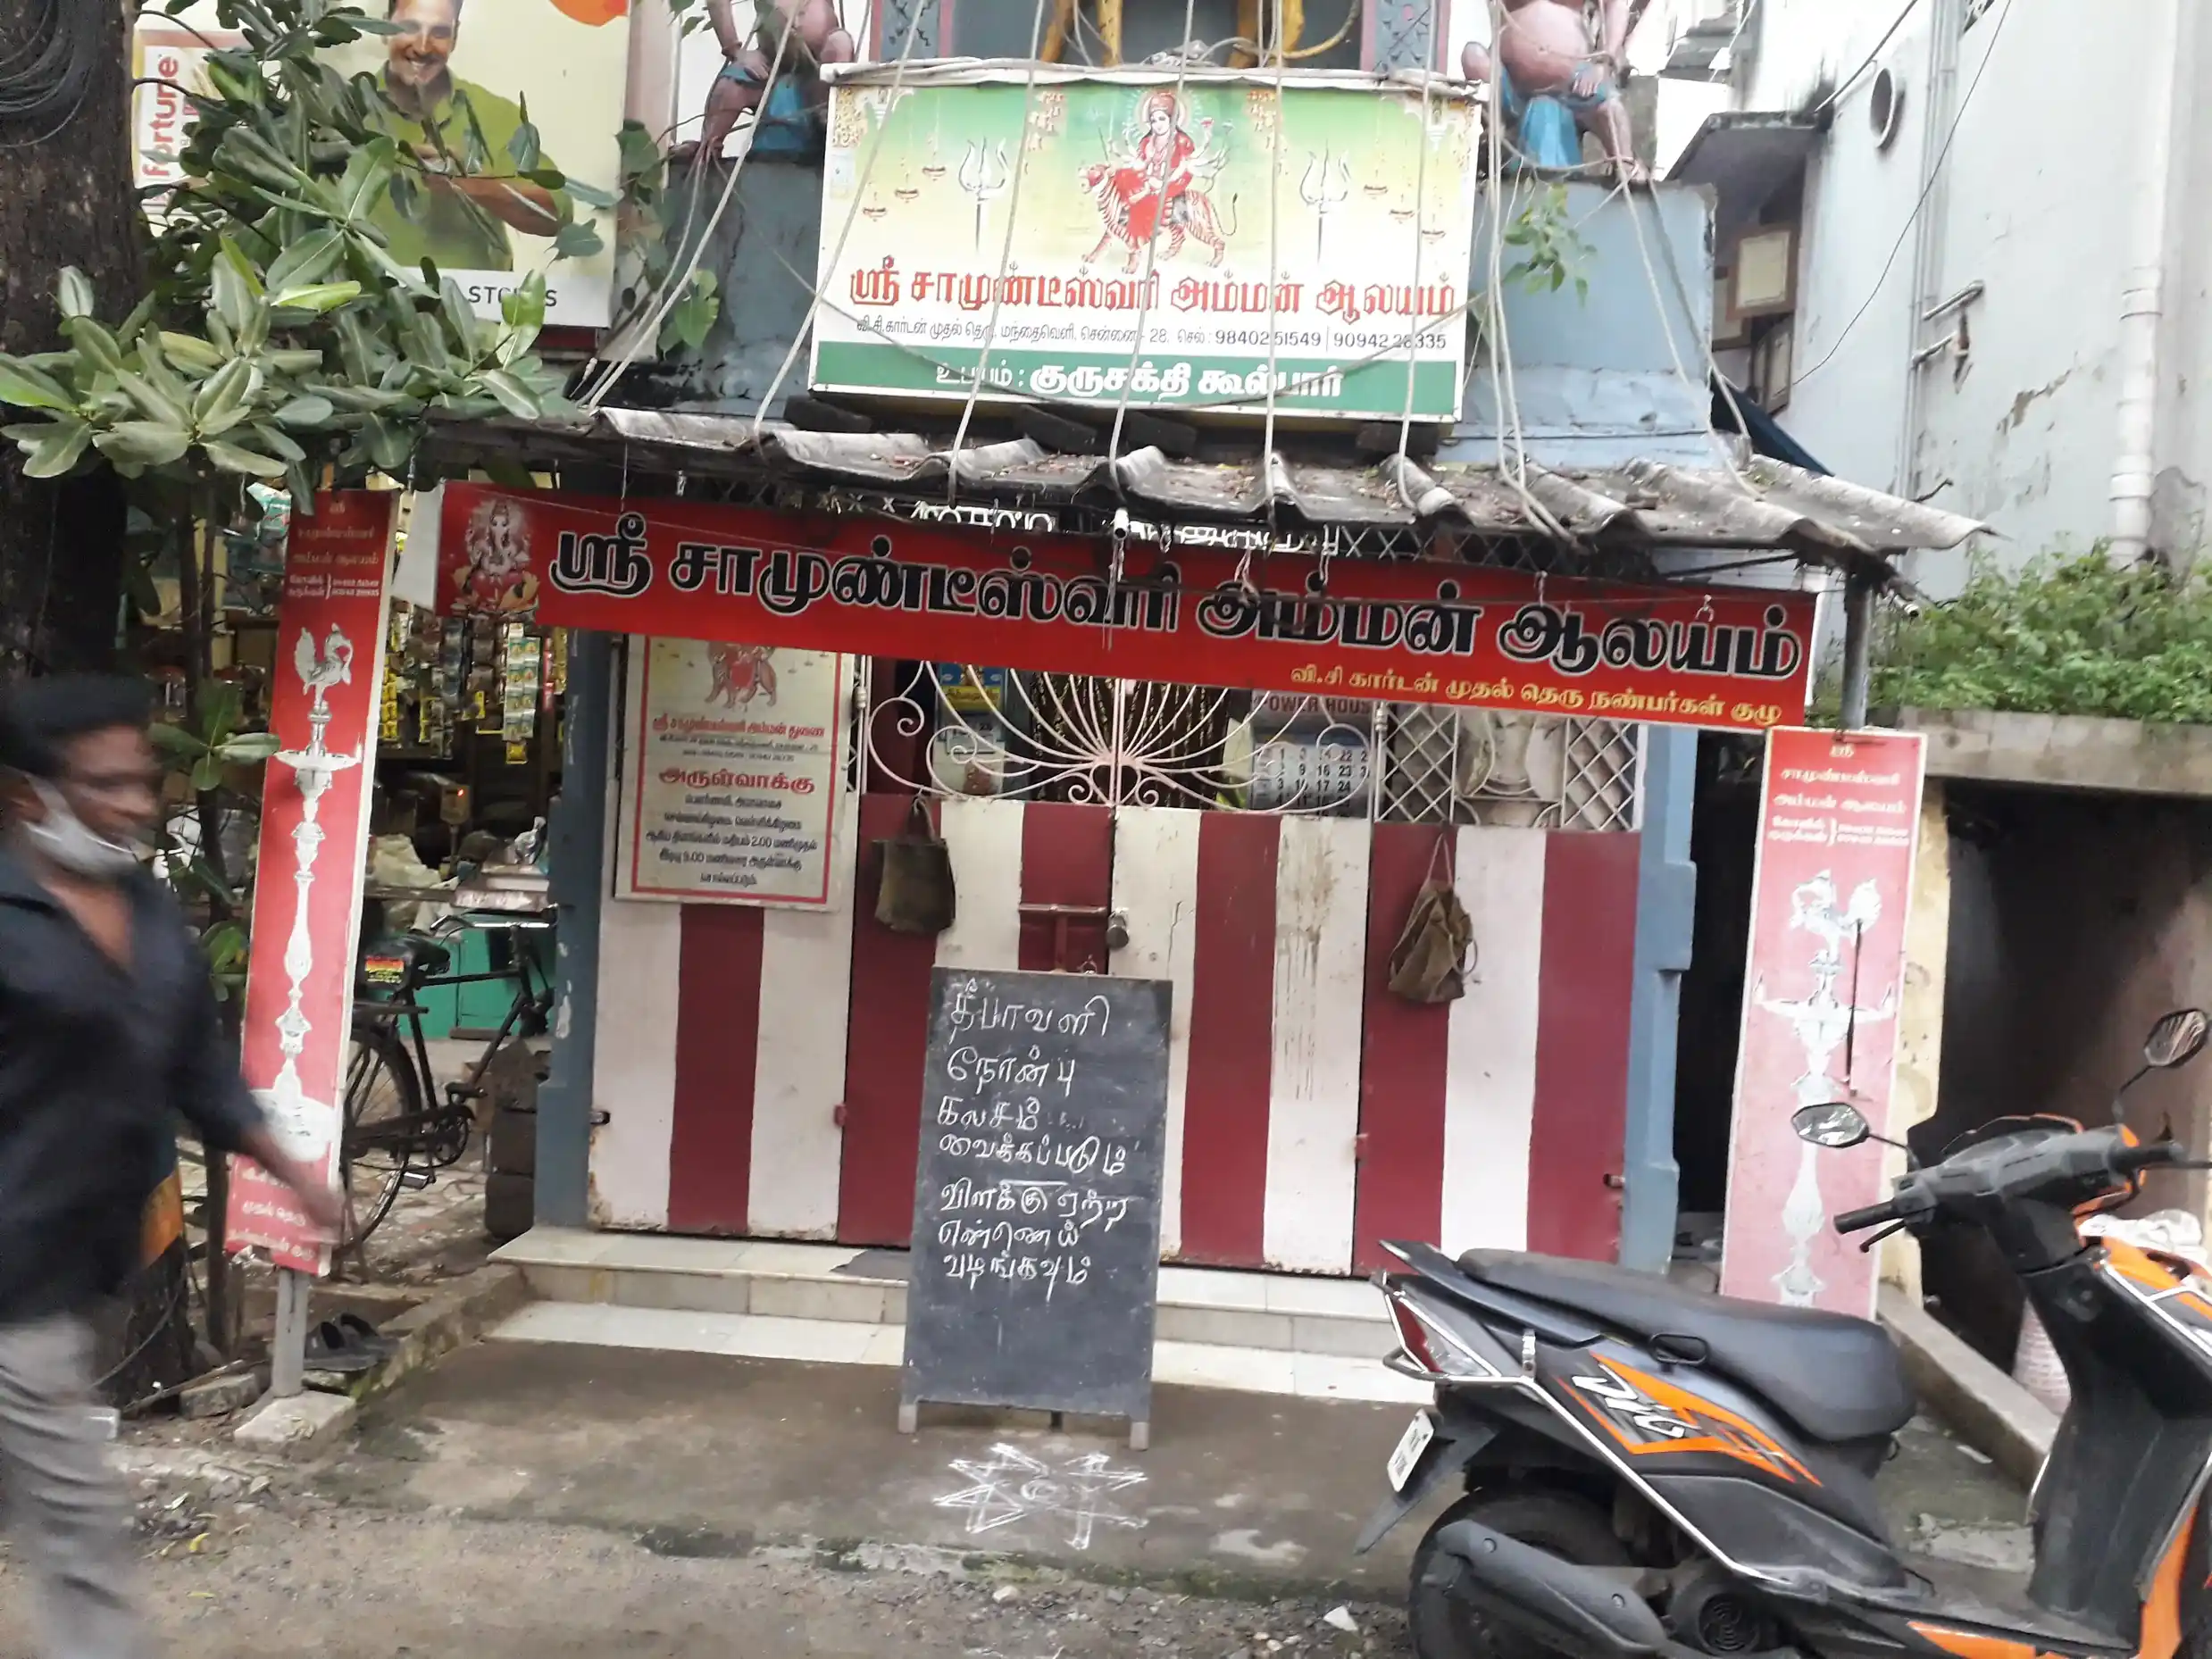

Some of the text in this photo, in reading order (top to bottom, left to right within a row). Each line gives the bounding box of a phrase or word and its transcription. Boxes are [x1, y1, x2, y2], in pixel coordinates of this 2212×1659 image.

[467, 285, 558, 307] STOS
[850, 255, 900, 306] ஸ்ரீ
[1171, 270, 1305, 313] அம்மன்
[1316, 271, 1456, 325] ஆலயம்
[930, 319, 962, 340] முதல்
[1030, 359, 1191, 402] குருசக்தி
[550, 512, 652, 599] ஸ்ரீ
[669, 535, 1180, 632] சாமுண்டீஸ்வரி
[1198, 570, 1484, 656] அம்மன்
[1498, 601, 1804, 678] ஆலயம்
[1349, 668, 1440, 694] கார்டன்
[1446, 676, 1515, 701] முதல்
[1521, 680, 1584, 709] தெரு
[1591, 688, 1727, 718] நண்பர்கள்
[1731, 702, 1782, 726] குழு
[937, 1095, 1042, 1131] கலசம்
